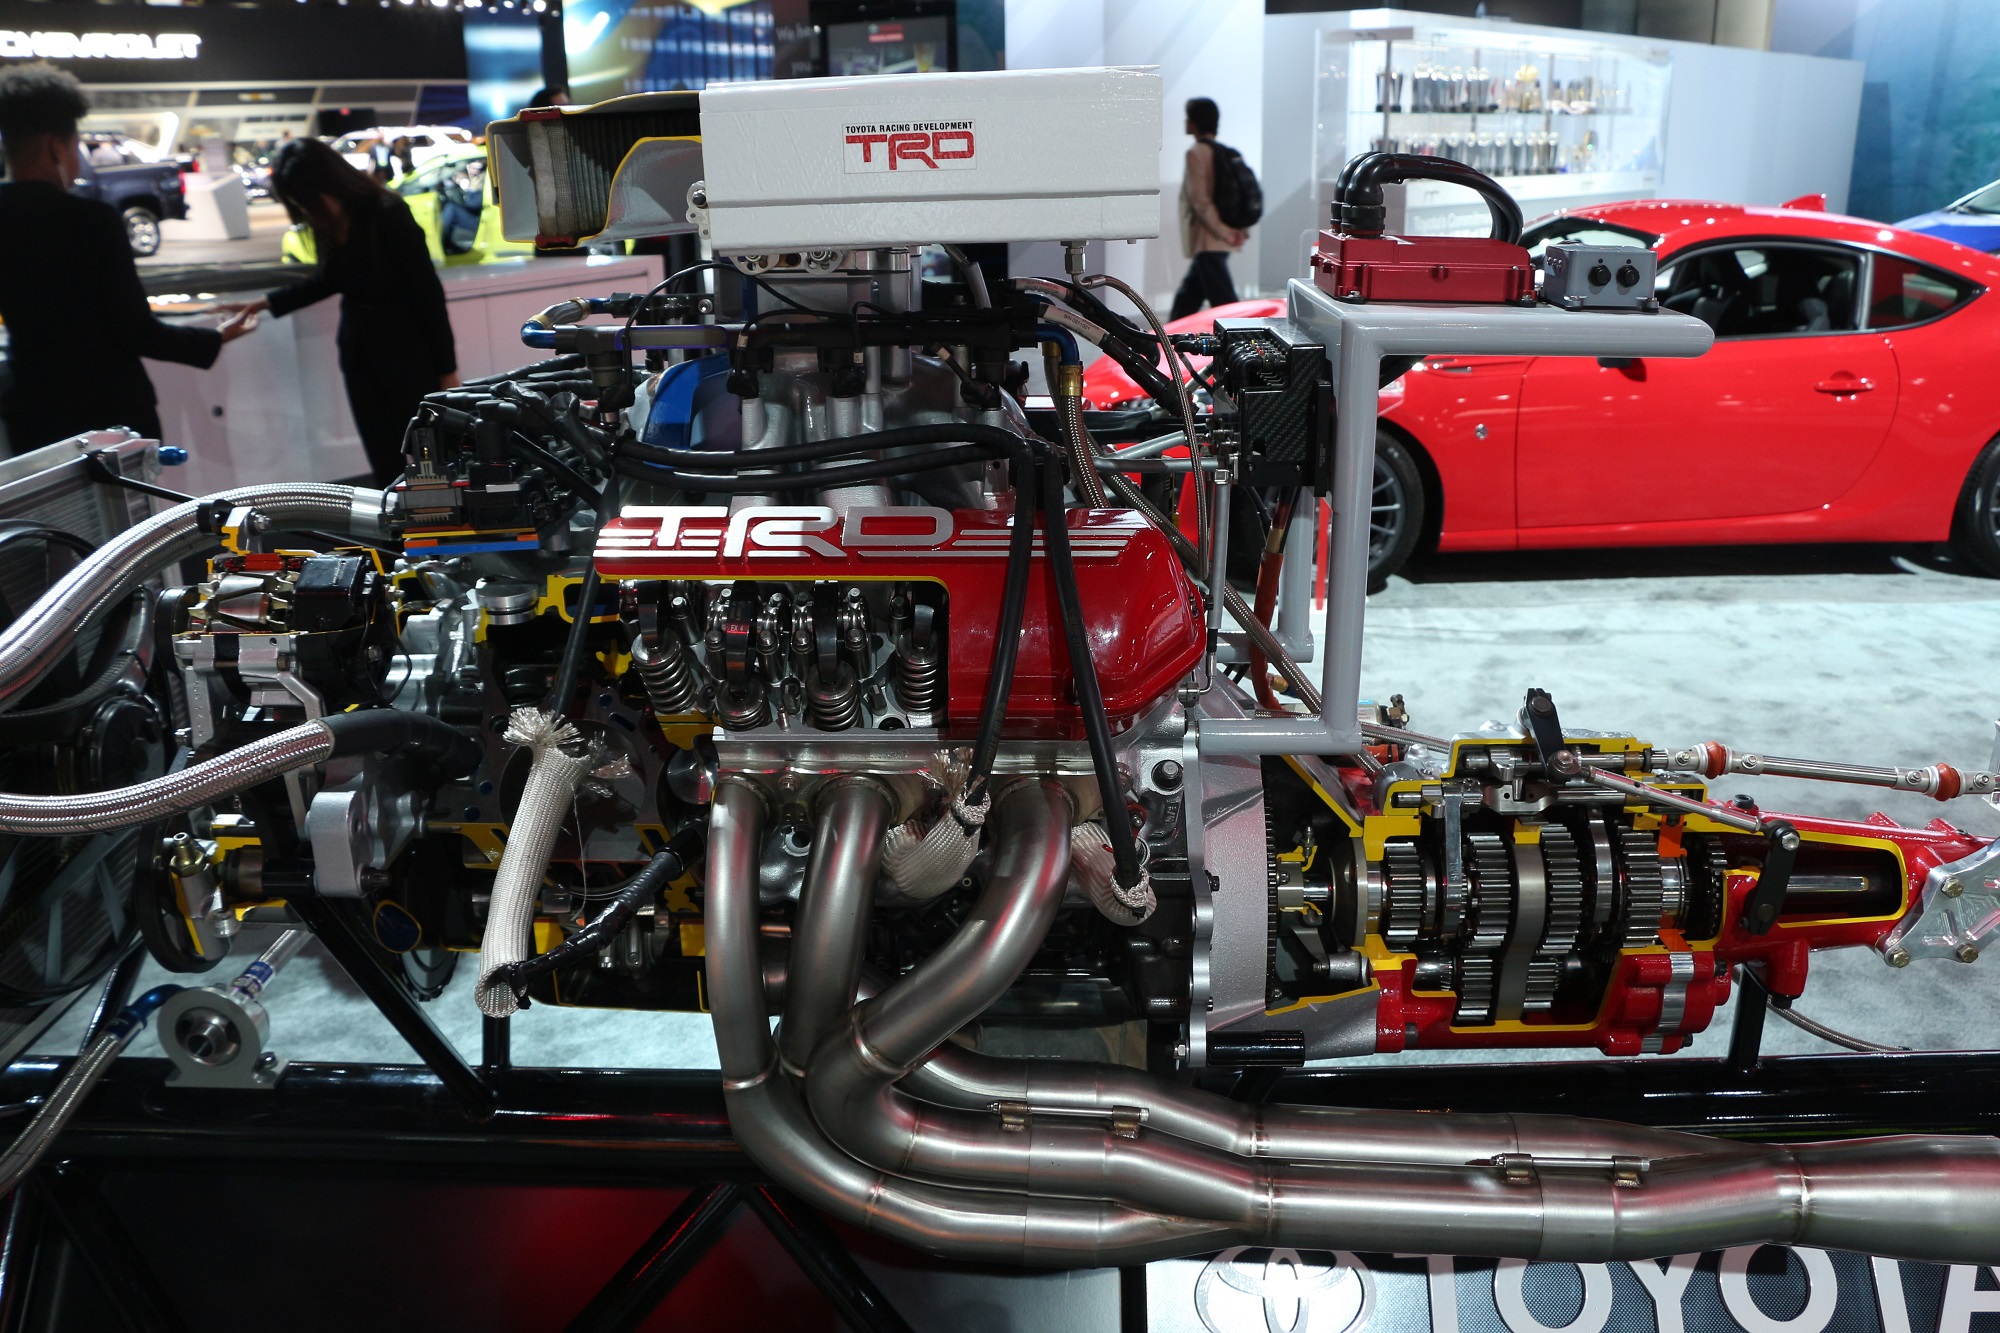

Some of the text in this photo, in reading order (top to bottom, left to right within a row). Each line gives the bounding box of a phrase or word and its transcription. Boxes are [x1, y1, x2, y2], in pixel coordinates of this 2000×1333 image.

[846, 121, 973, 133] TOYOTA RACING DEVELOPMENT
[846, 131, 974, 170] TRD
[620, 505, 953, 557] TRD
